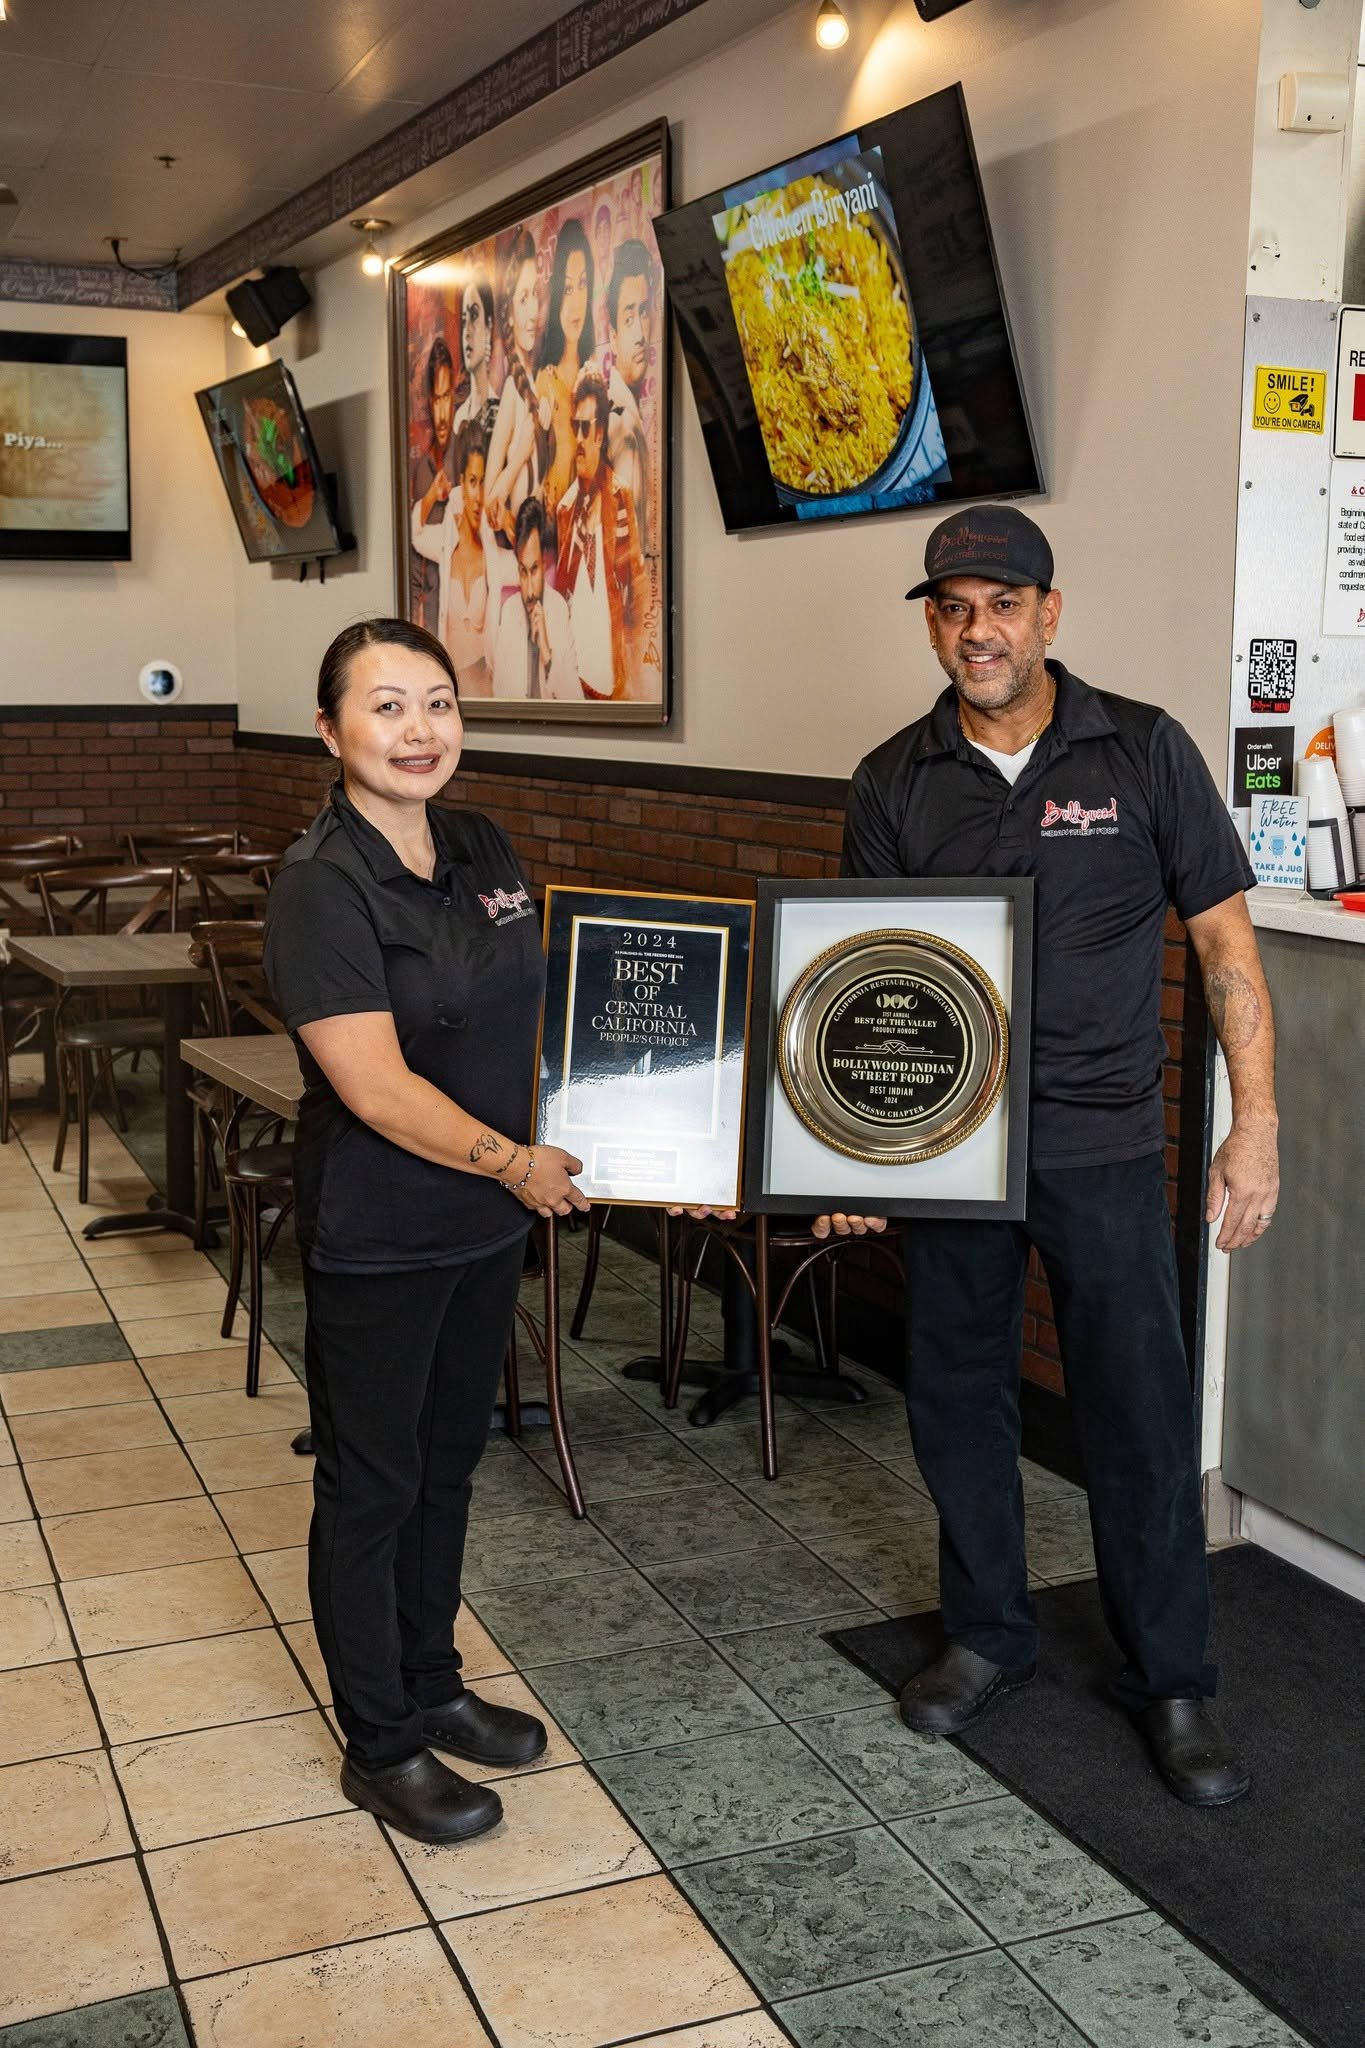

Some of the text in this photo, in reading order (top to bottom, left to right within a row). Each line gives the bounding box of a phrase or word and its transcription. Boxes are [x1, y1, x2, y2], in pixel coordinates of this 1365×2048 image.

[750, 171, 878, 251] Chicken Biryani
[1268, 373, 1315, 392] SMILE!
[1256, 416, 1321, 430] YOU'RE ON CAMERA
[4, 432, 63, 450] Piya...
[1338, 521, 1352, 529] state
[1344, 533, 1356, 541] food
[1337, 546, 1362, 556] providing
[1274, 702, 1290, 712] MENU
[1246, 754, 1281, 770] Uber
[1246, 773, 1281, 789] Eats
[1041, 797, 1117, 830] Bollywood
[1261, 800, 1298, 814] FREE
[1260, 812, 1298, 828] Water
[1255, 862, 1275, 871] TAKE
[1278, 864, 1284, 872] A
[1274, 875, 1304, 885] SERVED
[622, 932, 677, 949] 2024
[613, 958, 684, 985] BEST
[634, 984, 661, 1001] OF
[605, 1000, 688, 1020] CENTRAL
[833, 979, 959, 1028] CALIFORNIA RESTAURANT ASSOCIATION
[591, 1016, 698, 1037] CALIFORNIA
[854, 1017, 938, 1029] BEST OF THE VALLEY
[872, 1026, 896, 1034] PROUDLY
[600, 1032, 689, 1047] PEOPLE'S CHOICE
[832, 1058, 955, 1075] BOLLYWOOD INDIAN
[851, 1070, 935, 1084] STREET FOOD
[869, 1086, 914, 1097] BEST INDIAN
[855, 1100, 925, 1118] FRESNO CHAPTER
